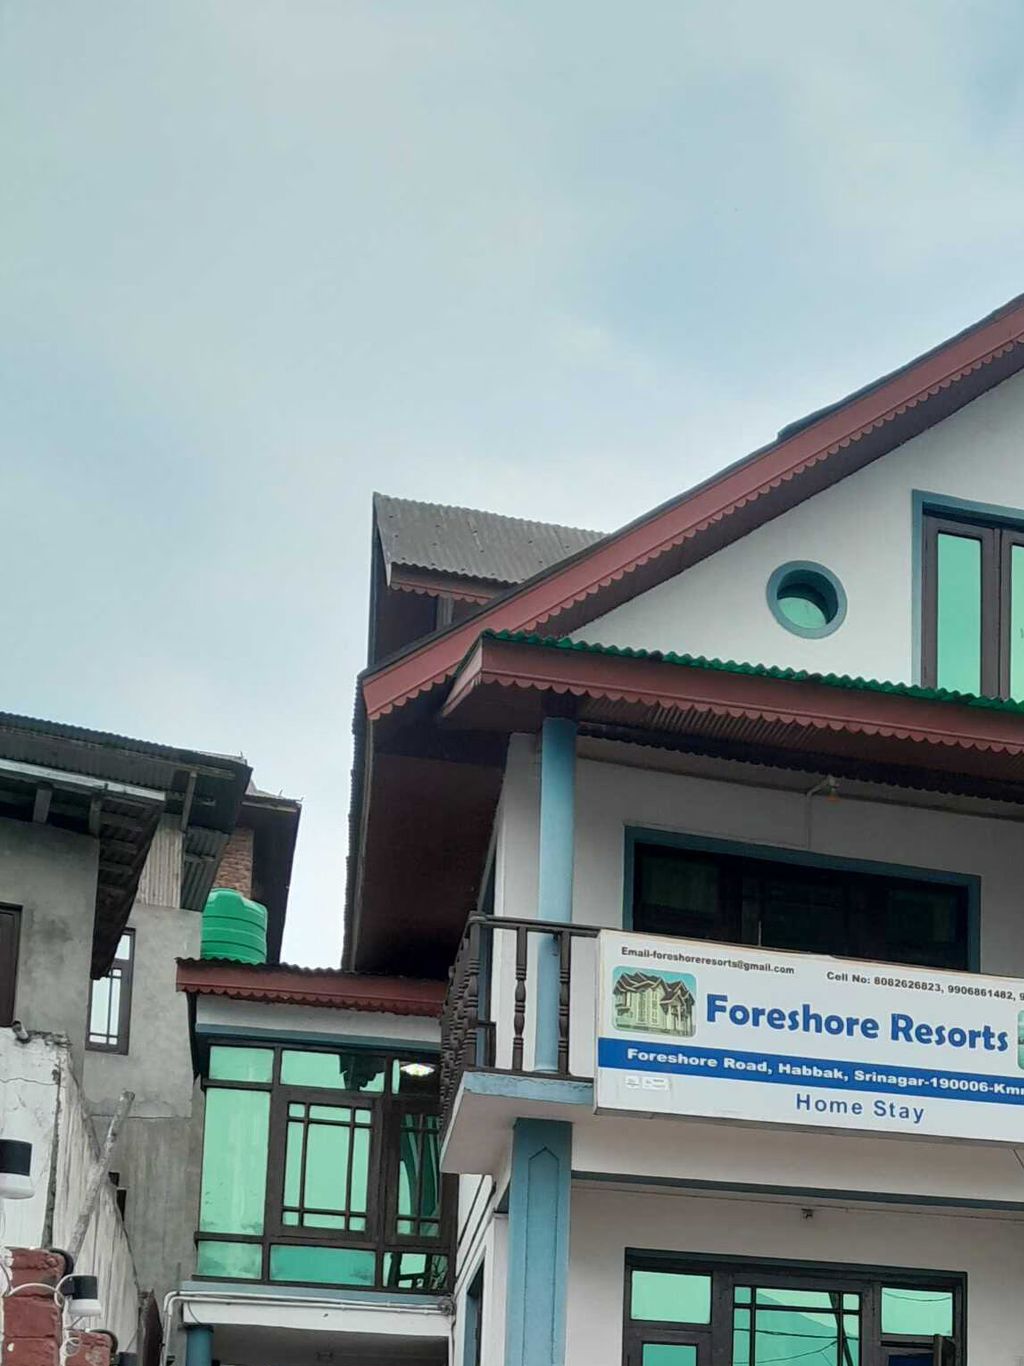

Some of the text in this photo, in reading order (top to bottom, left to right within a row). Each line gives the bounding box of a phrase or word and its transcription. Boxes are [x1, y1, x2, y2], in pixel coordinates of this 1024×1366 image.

[826, 971, 848, 981] Cell
[852, 974, 871, 984] No:
[706, 993, 1009, 1051] Foreshore Resorts
[627, 1048, 718, 1068] Foreshore
[723, 1056, 773, 1075] Road,
[778, 1063, 849, 1081] Habbak,
[796, 1093, 925, 1124] Home Stay
